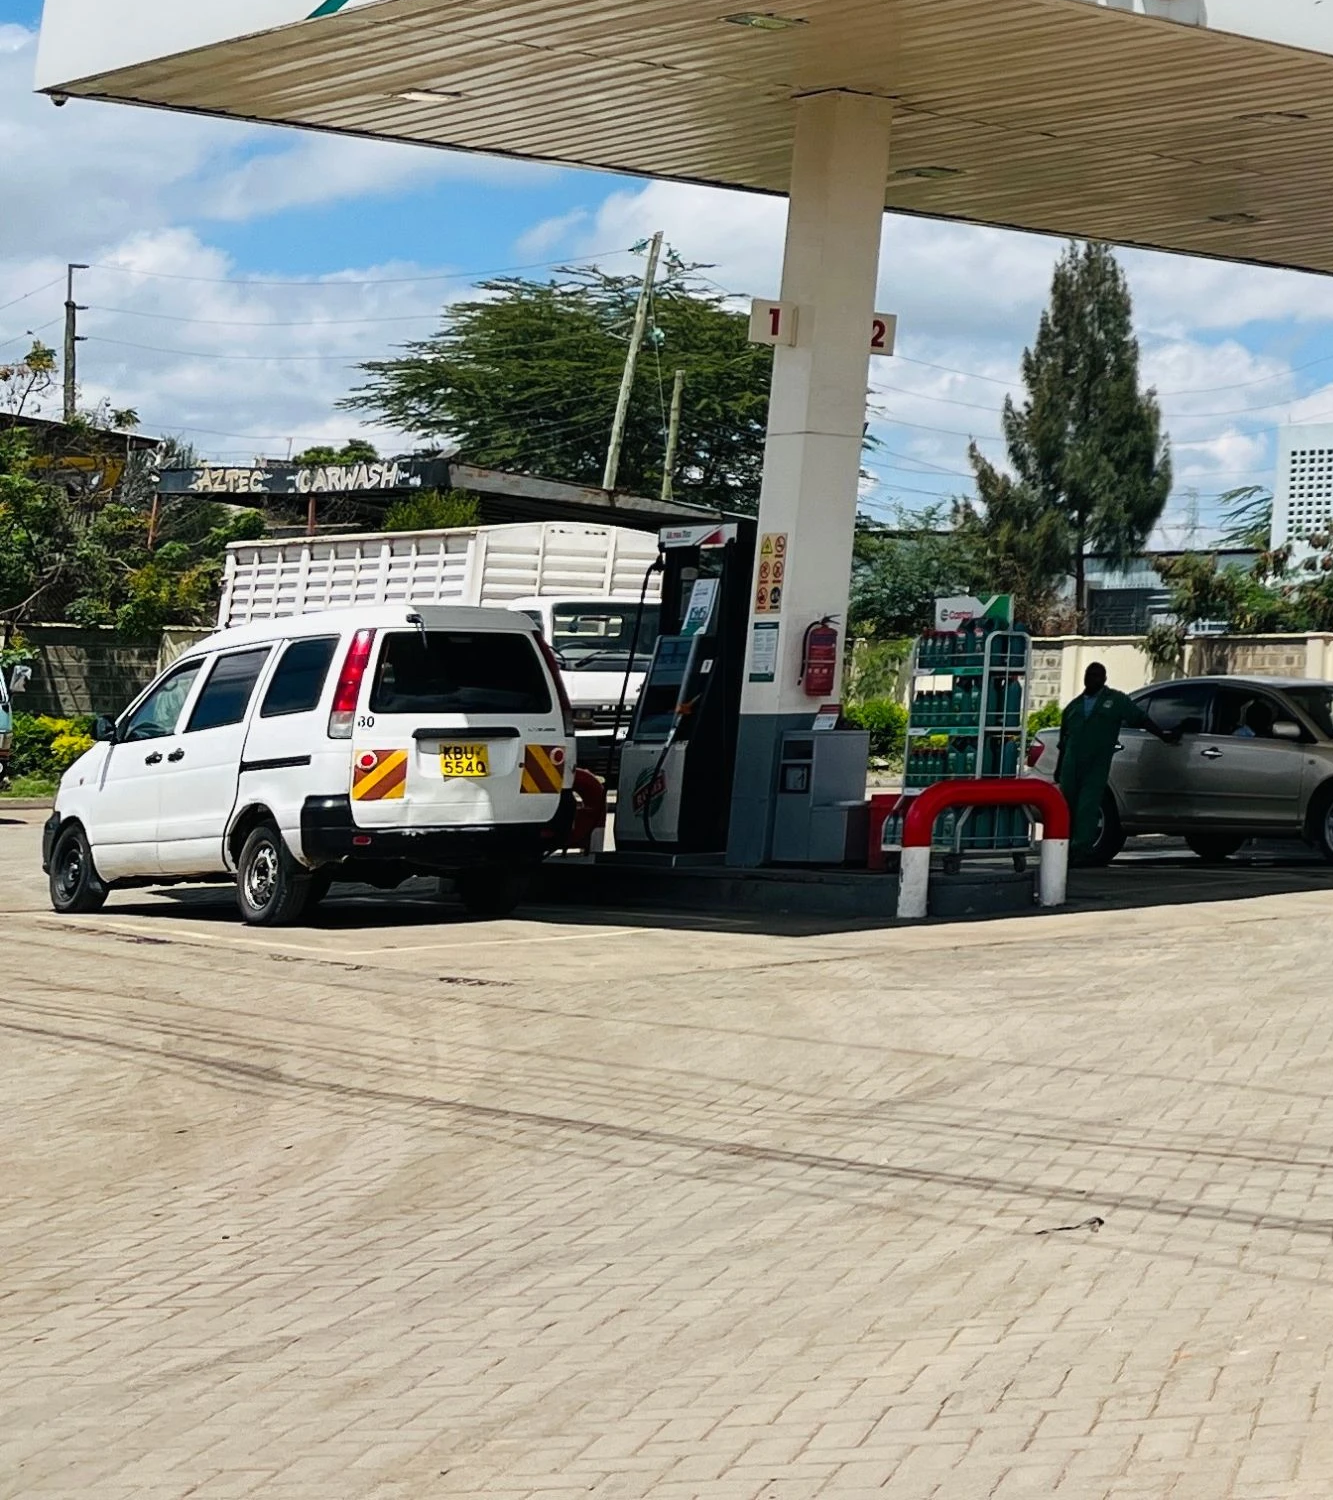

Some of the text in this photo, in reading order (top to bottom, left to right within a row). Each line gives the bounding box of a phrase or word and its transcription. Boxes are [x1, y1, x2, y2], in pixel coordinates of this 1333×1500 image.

[769, 308, 781, 336] 1
[871, 319, 886, 348] 2
[196, 462, 400, 493] AZTEC CARWASH
[443, 746, 474, 760] KBU
